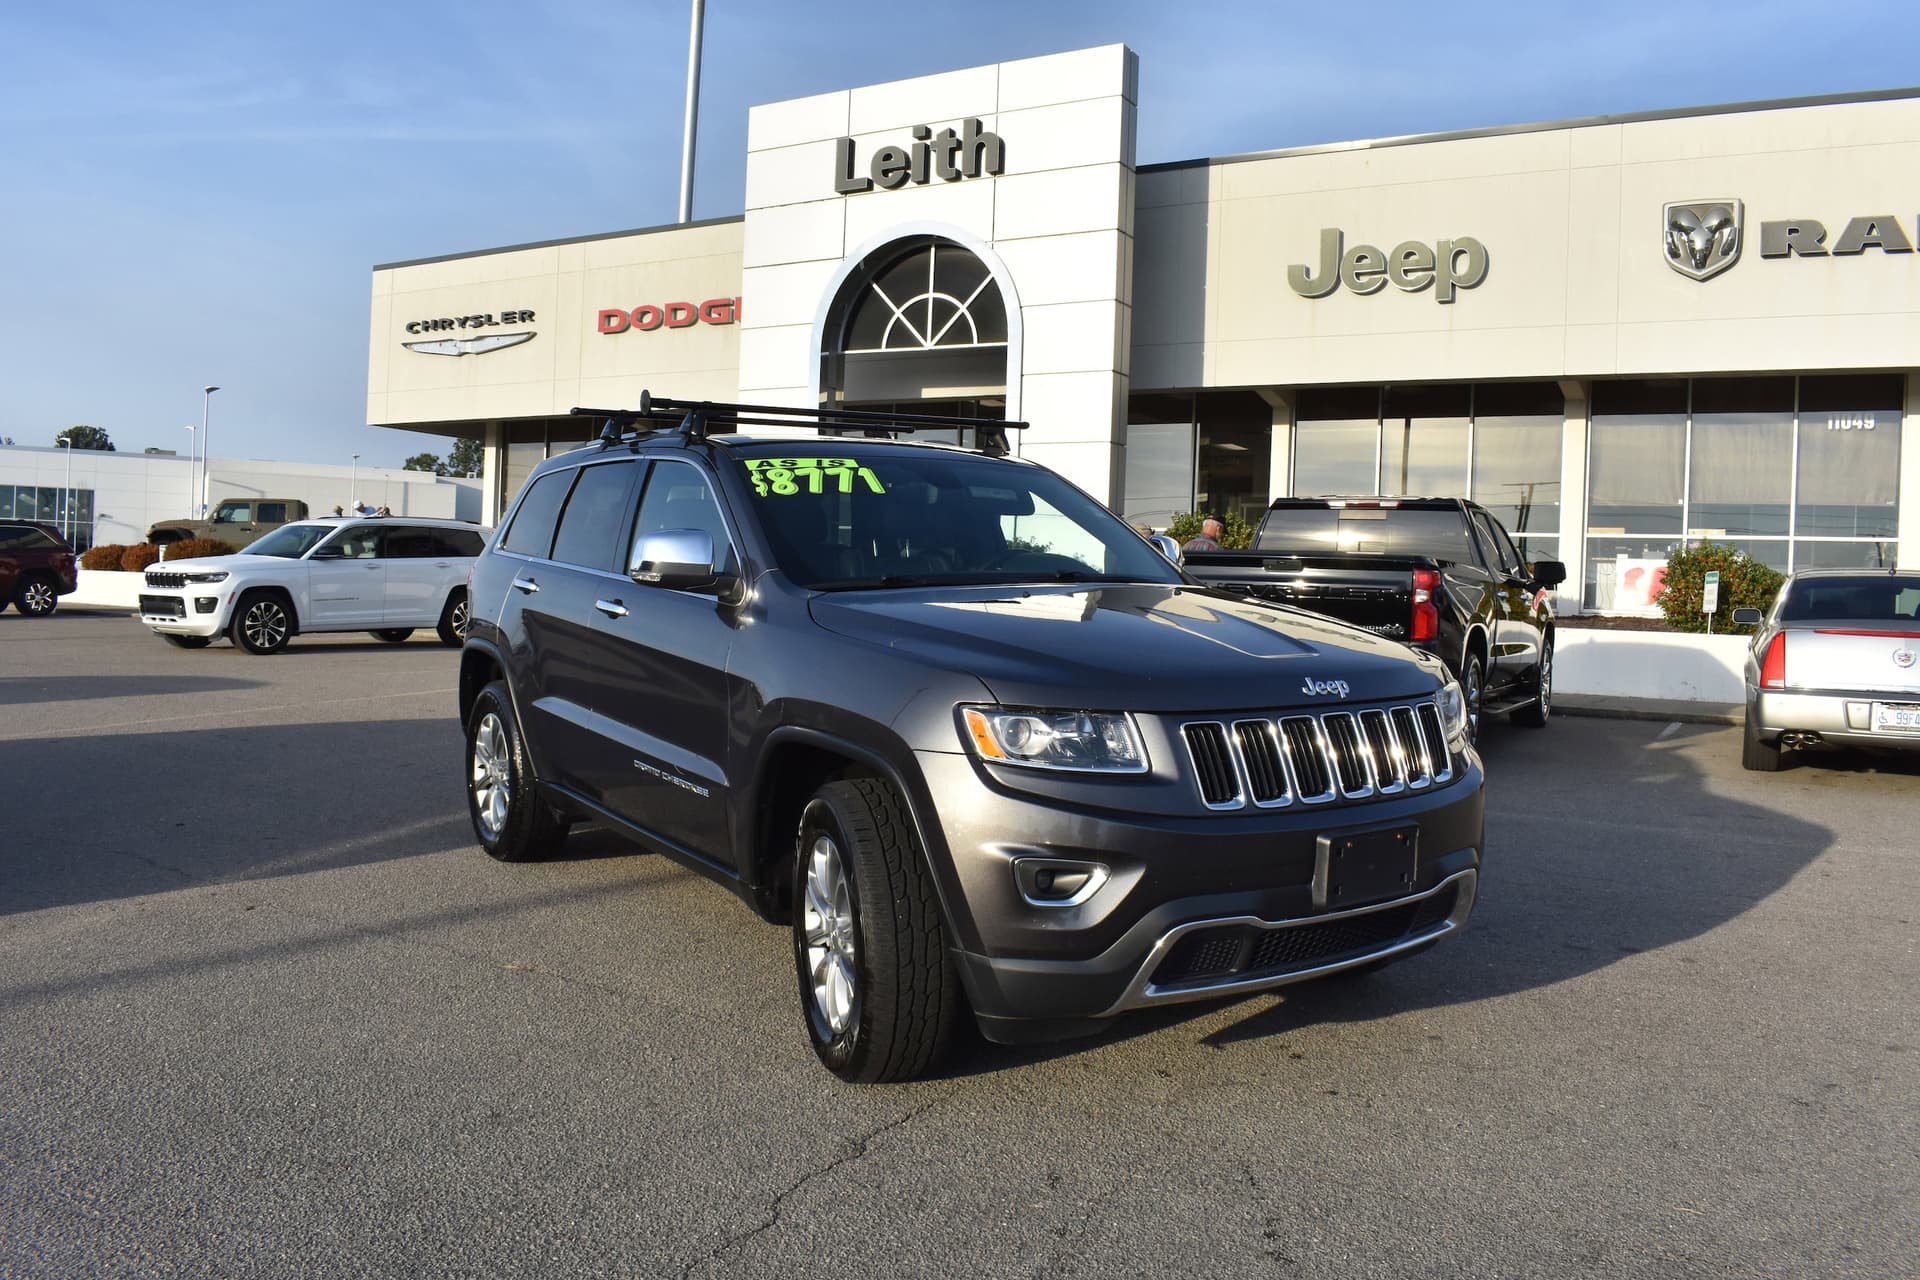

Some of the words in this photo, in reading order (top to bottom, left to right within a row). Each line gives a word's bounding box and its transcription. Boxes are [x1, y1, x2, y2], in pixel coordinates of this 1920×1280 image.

[834, 117, 1006, 195] Leith
[1760, 214, 1920, 260] RA
[1287, 227, 1490, 305] Jeep
[405, 309, 536, 335] CHRYSLER
[755, 459, 798, 468] AS
[816, 459, 847, 467] IS
[750, 467, 886, 497] $8771
[1301, 676, 1350, 699] Jeep
